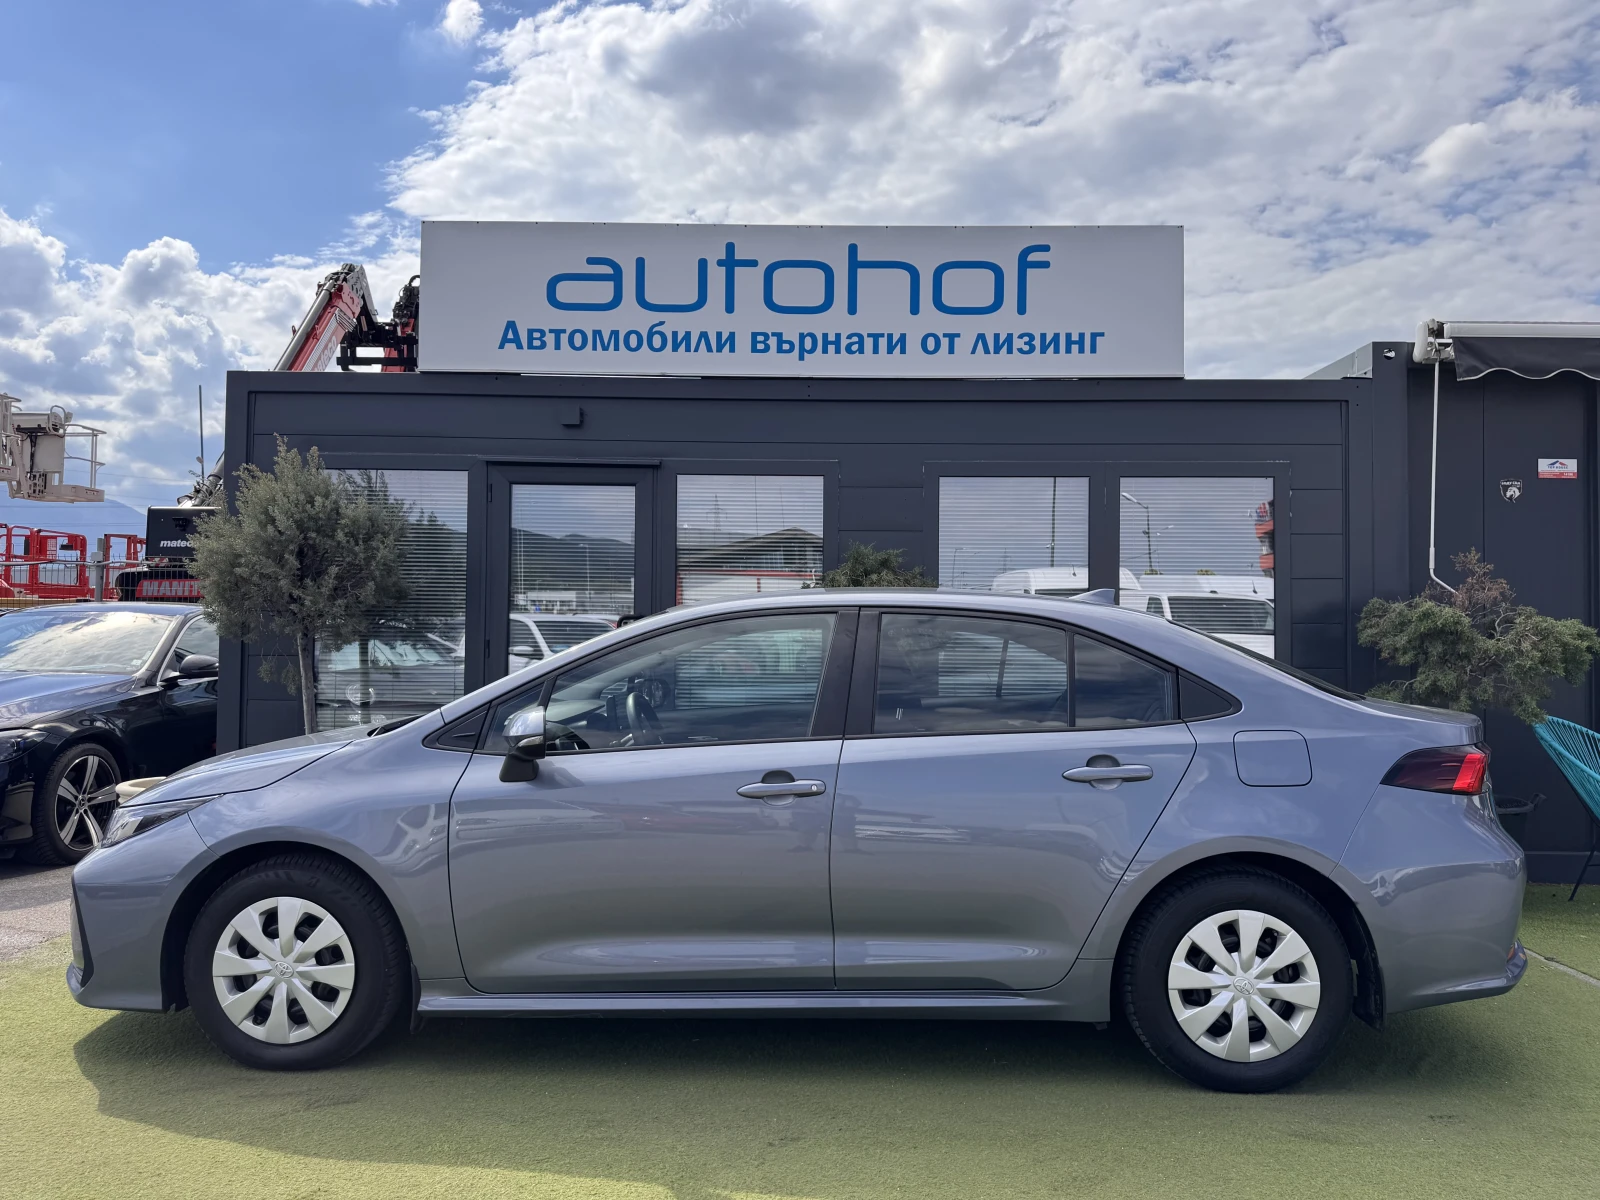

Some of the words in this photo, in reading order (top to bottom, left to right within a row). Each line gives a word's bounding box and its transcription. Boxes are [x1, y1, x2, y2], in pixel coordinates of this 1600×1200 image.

[545, 241, 1051, 316] autohof
[315, 335, 337, 371] ateco
[498, 320, 736, 354] Автомобили
[750, 331, 907, 362] върнати
[920, 332, 961, 356] от
[970, 331, 1106, 356] лизинг
[160, 539, 194, 548] matec
[142, 581, 201, 596] MANIT
